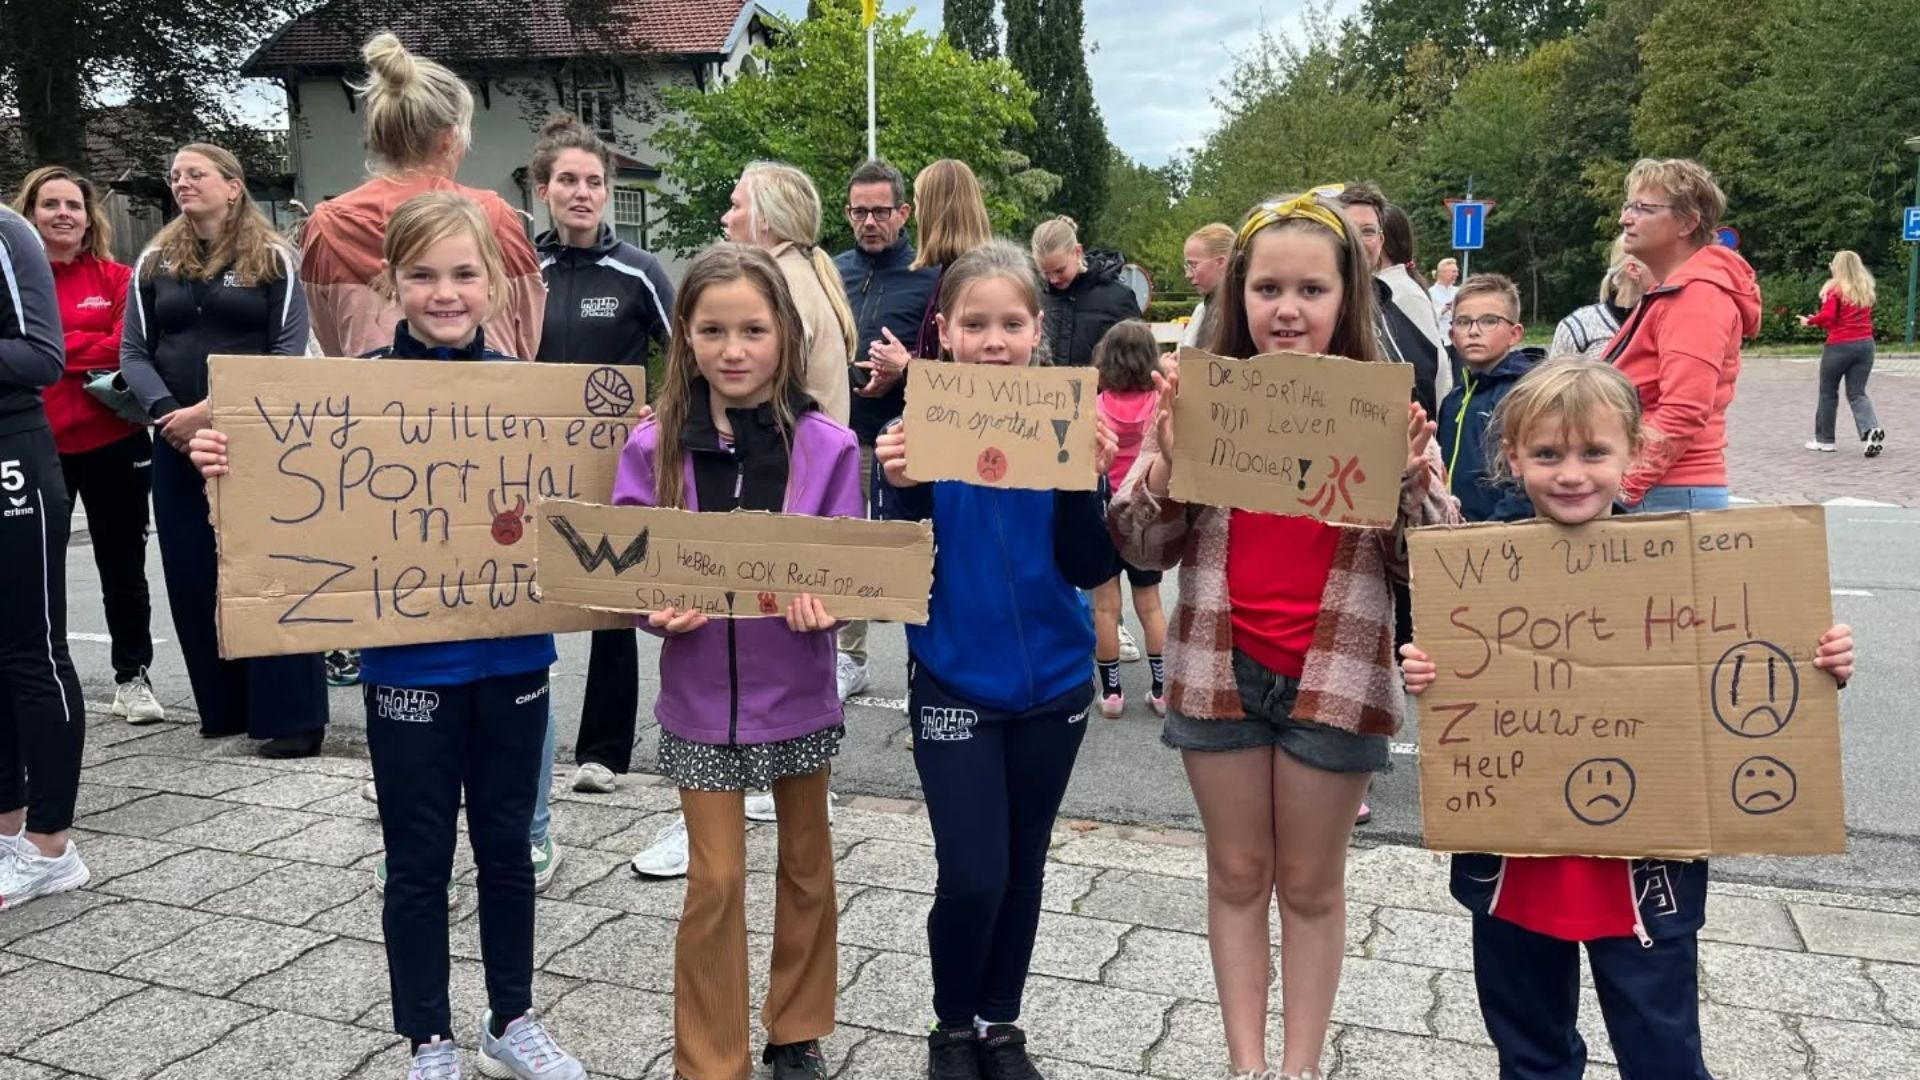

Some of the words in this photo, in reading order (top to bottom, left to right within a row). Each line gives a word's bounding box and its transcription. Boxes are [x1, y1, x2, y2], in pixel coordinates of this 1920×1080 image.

[927, 405, 961, 428] een
[565, 419, 629, 450] een
[1, 459, 25, 491] 5
[4, 506, 34, 517] erima
[393, 508, 449, 542] in
[1700, 530, 1754, 552] een
[857, 585, 884, 598] een
[1533, 658, 1572, 692] in
